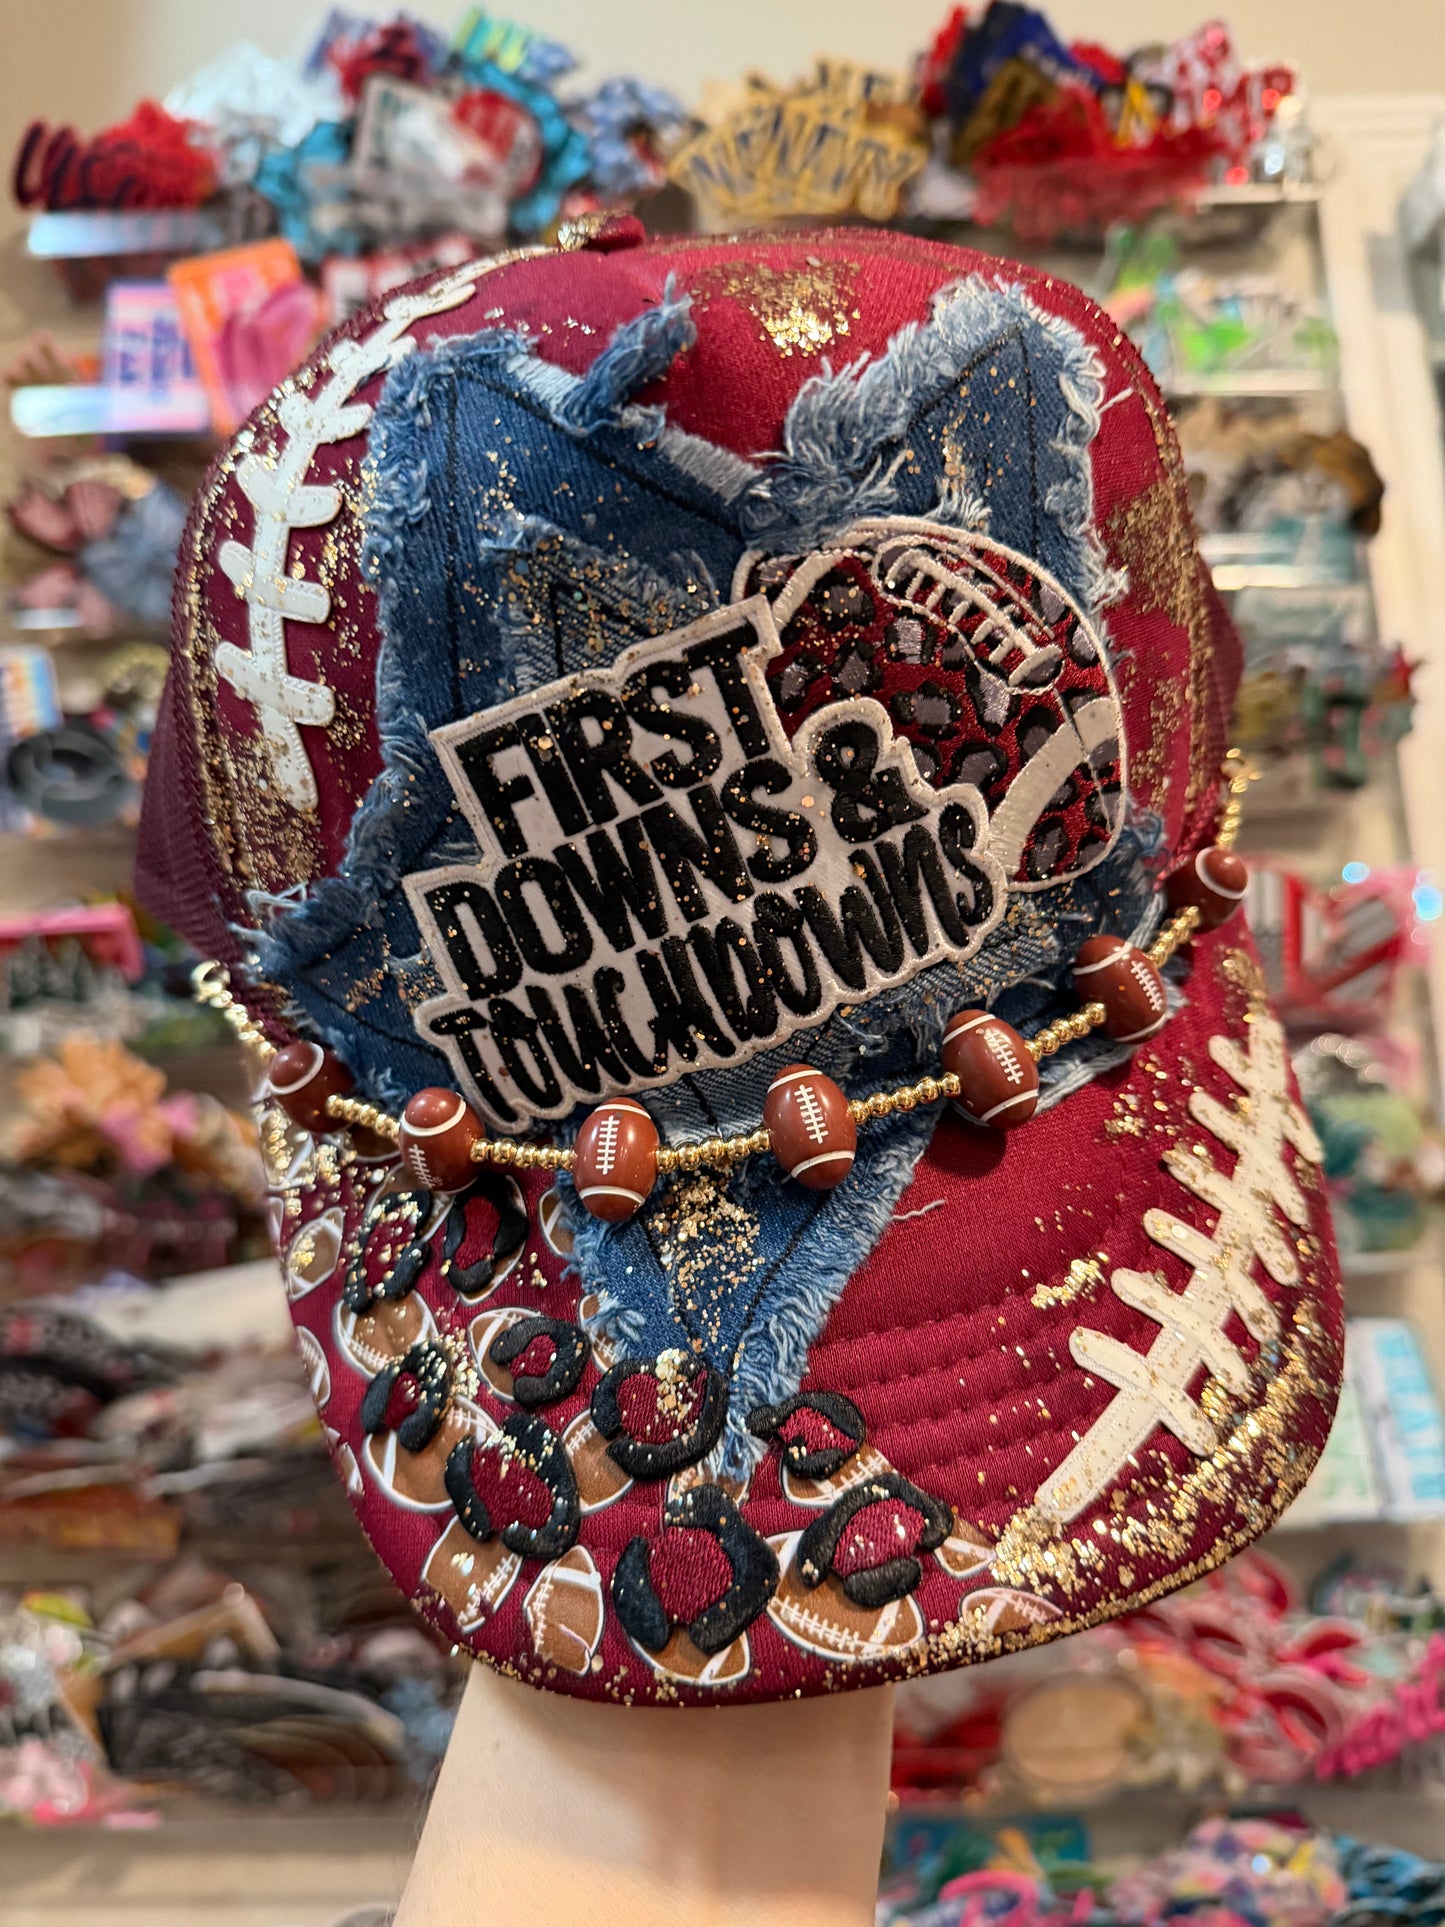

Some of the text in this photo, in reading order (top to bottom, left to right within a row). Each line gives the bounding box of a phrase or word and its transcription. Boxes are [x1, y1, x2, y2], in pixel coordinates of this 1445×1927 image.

[423, 718, 929, 1000] DOWNS &
[454, 621, 771, 858] FIRST
[429, 802, 995, 1123] TOUCHDOWNS
